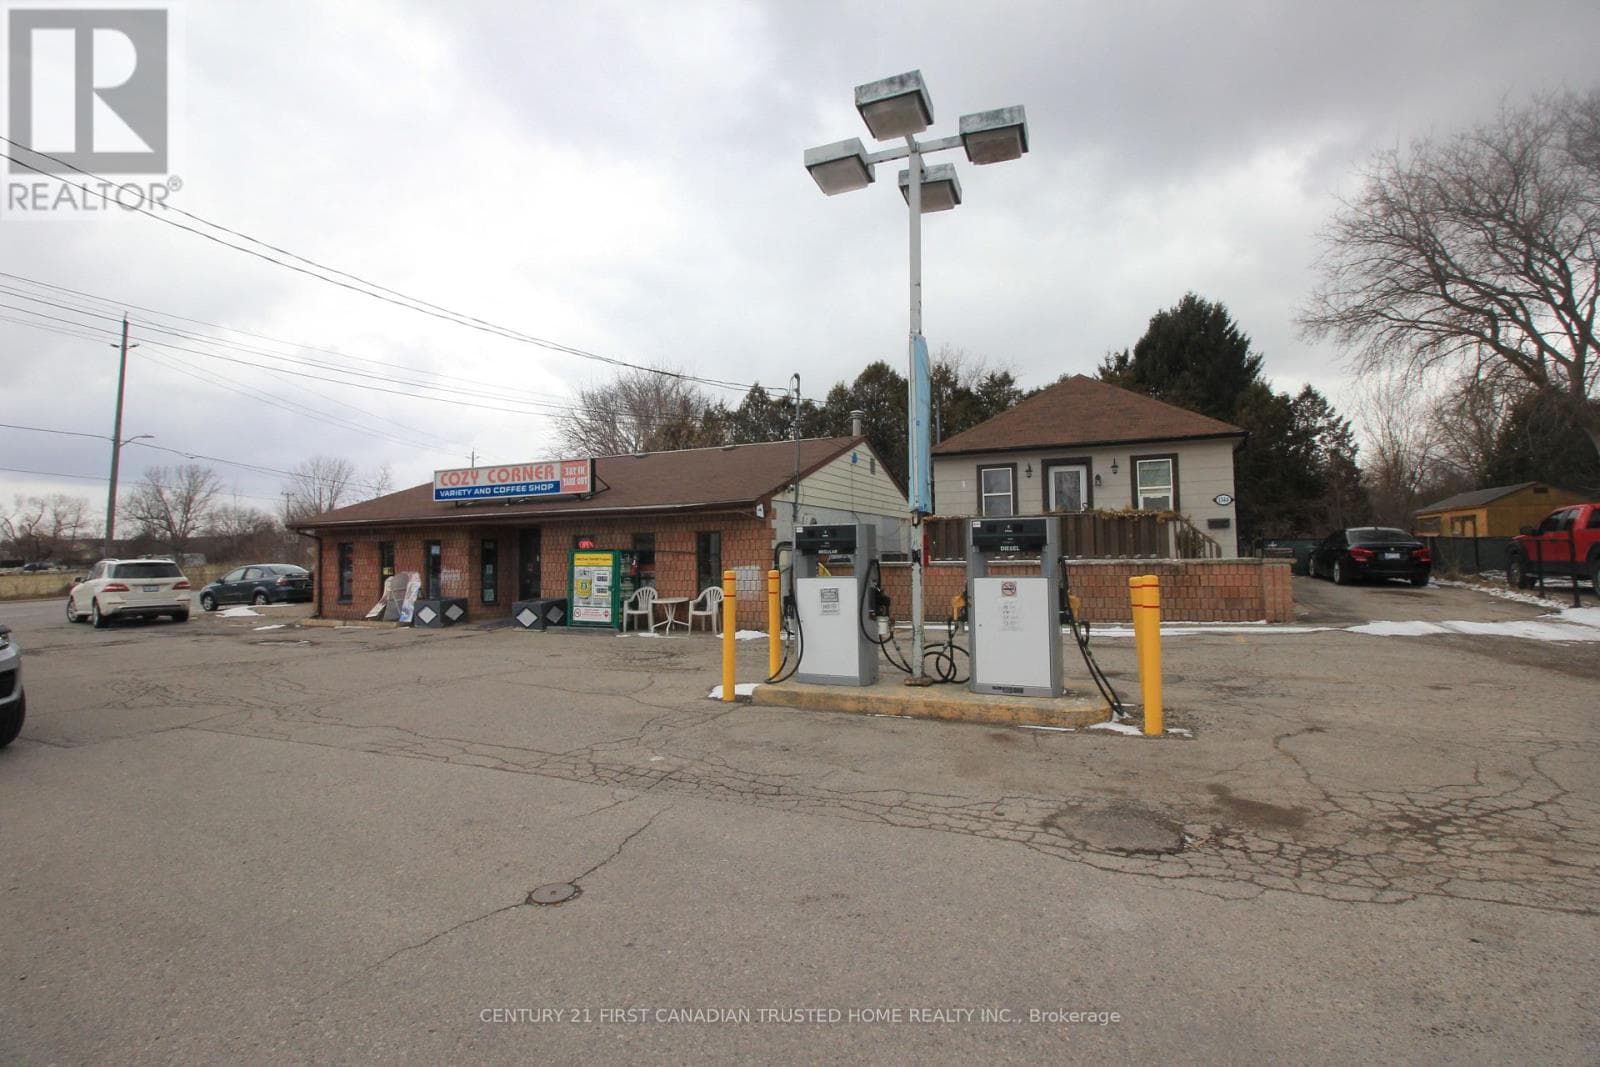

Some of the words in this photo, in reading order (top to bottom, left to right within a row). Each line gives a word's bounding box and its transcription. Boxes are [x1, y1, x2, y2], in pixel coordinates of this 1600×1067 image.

[440, 470, 479, 487] COZY
[488, 464, 555, 483] CORNER
[439, 488, 472, 497] VARIETY
[474, 487, 491, 495] AND
[493, 485, 527, 494] COFFEE
[528, 483, 554, 491] SHOP
